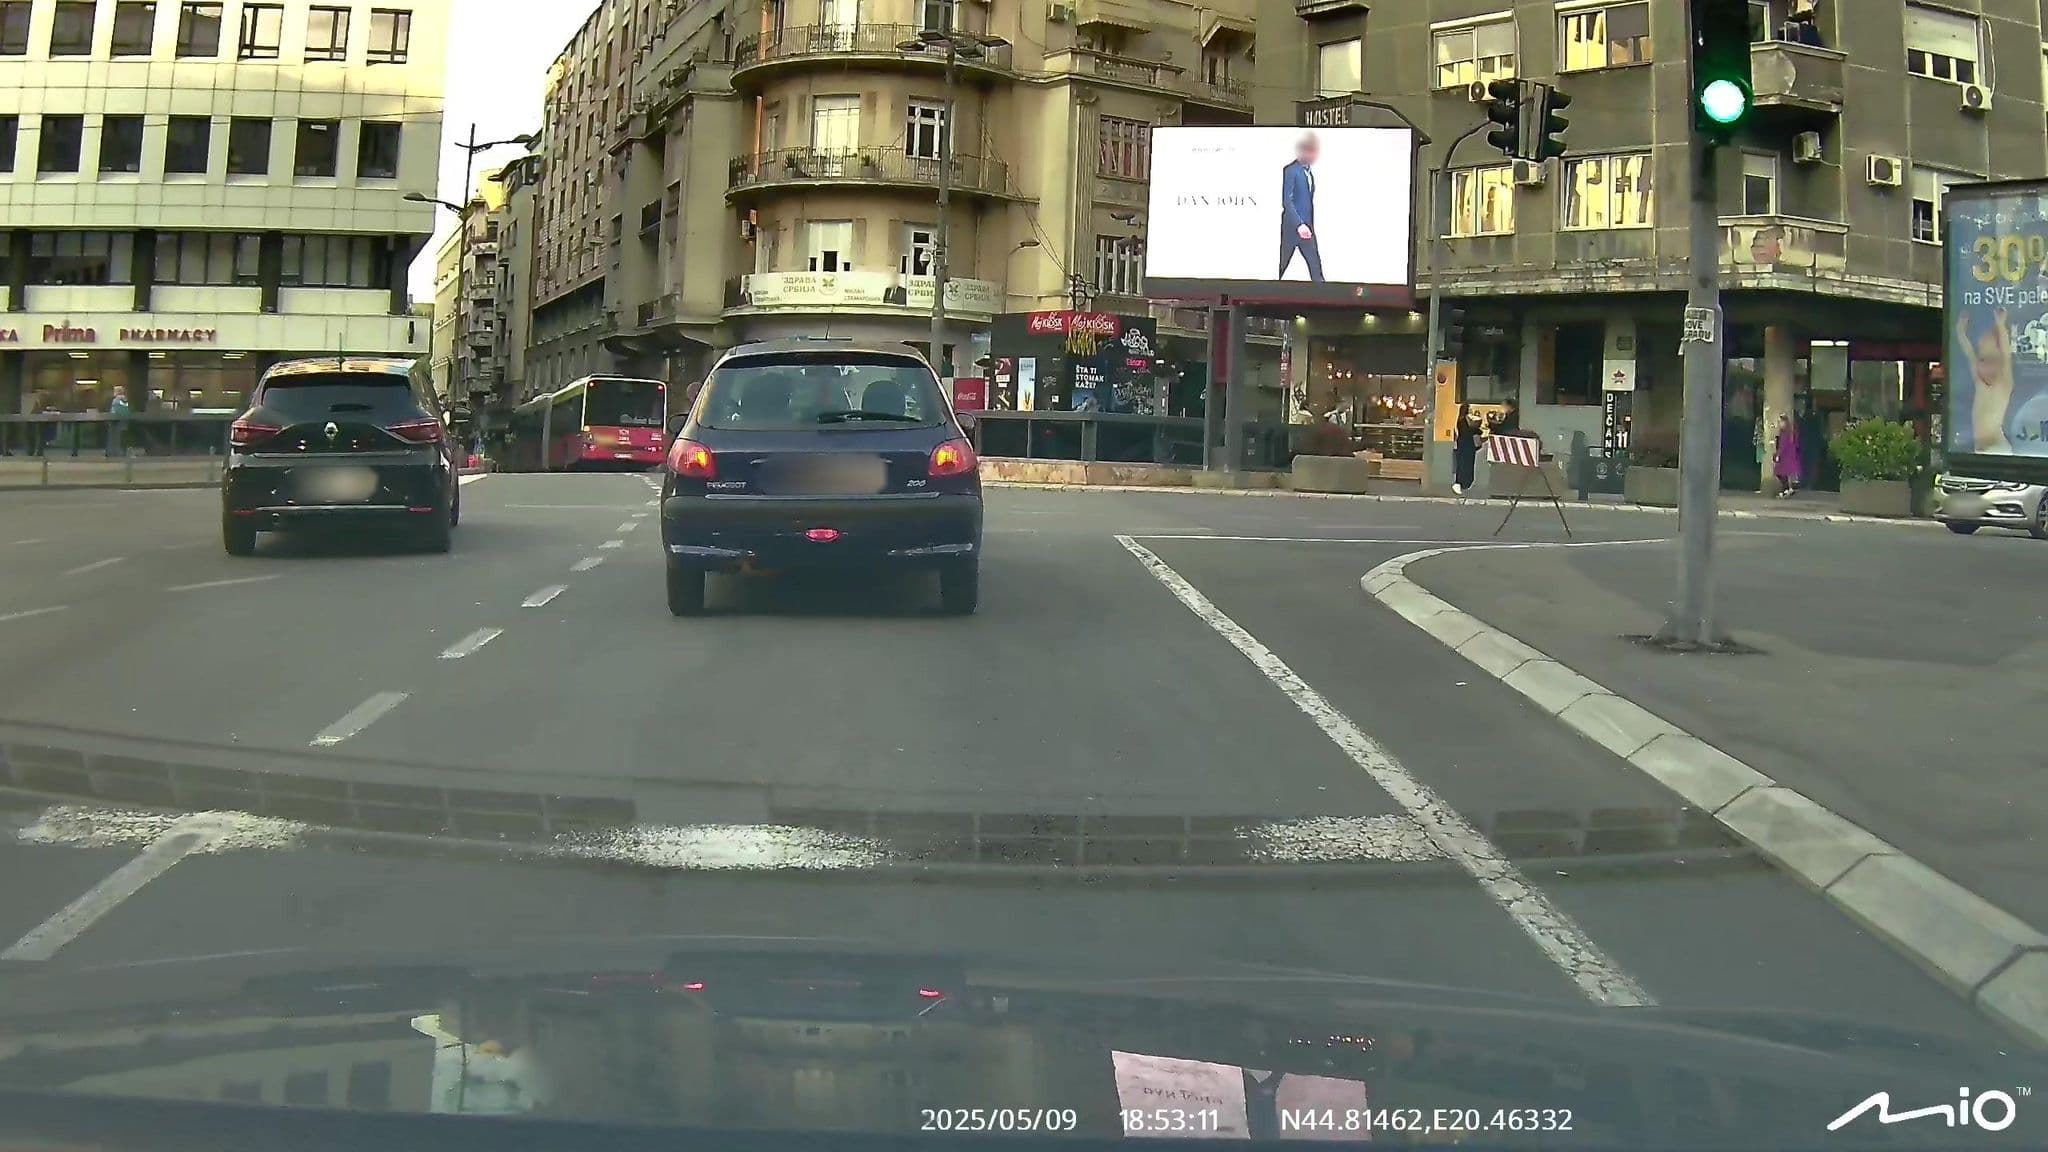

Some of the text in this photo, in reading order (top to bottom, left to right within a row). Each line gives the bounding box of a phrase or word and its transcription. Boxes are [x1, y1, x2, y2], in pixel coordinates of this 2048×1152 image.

[1305, 107, 1349, 126] HOSTEL
[1964, 291, 1981, 305] na
[1985, 286, 2015, 304] SVE
[1042, 313, 1063, 329] KIOSK
[1086, 314, 1115, 330] KIOSK
[43, 324, 95, 343] Prima
[119, 328, 217, 342] PHARMACY
[1075, 364, 1097, 374] ŠTA TI
[1075, 374, 1104, 382] STOMAK
[706, 481, 747, 489] PEUGEOT
[906, 480, 927, 488] 206
